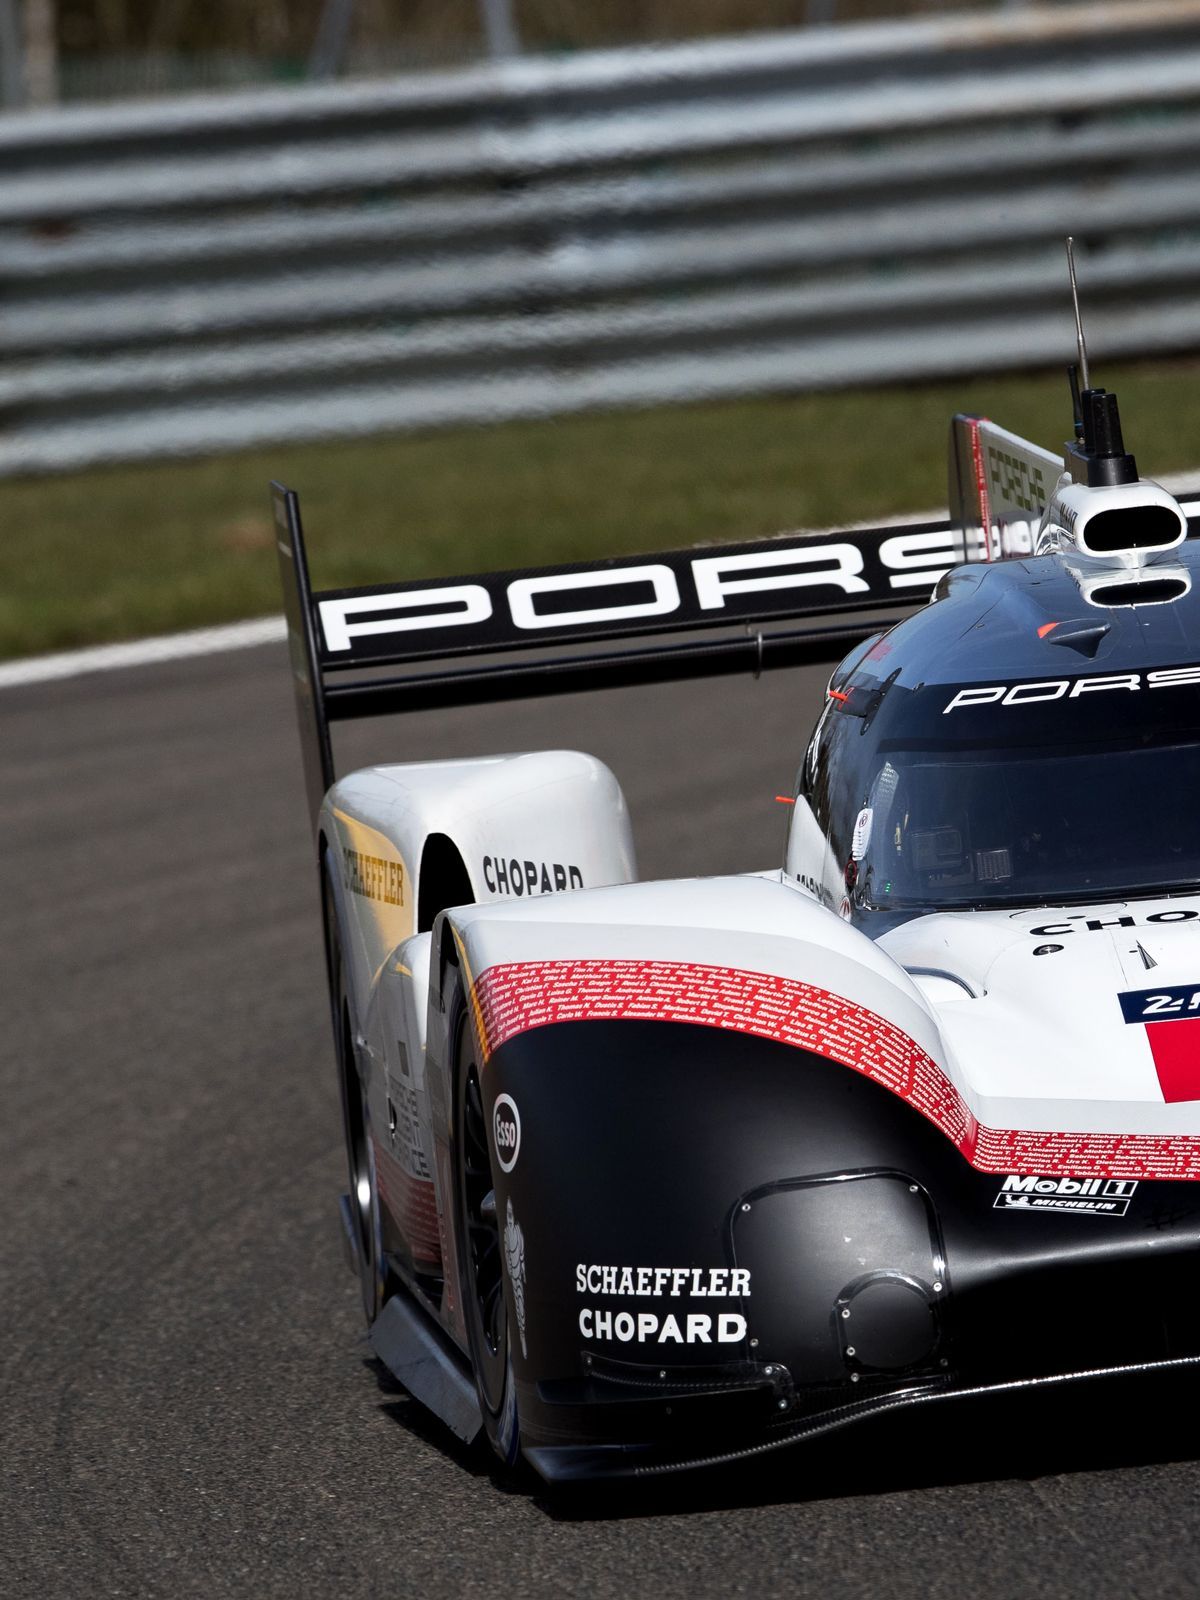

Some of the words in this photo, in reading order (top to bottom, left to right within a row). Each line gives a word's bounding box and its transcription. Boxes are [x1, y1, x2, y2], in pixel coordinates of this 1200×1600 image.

[343, 848, 404, 907] SCHAEFFLER
[483, 856, 584, 897] CHOPARD
[1001, 1175, 1102, 1196] Mobil
[1114, 1182, 1127, 1195] 1
[1032, 1198, 1117, 1210] MICHELIN
[576, 1263, 752, 1298] SCHAEFFLER
[579, 1308, 748, 1344] CHOPARD
